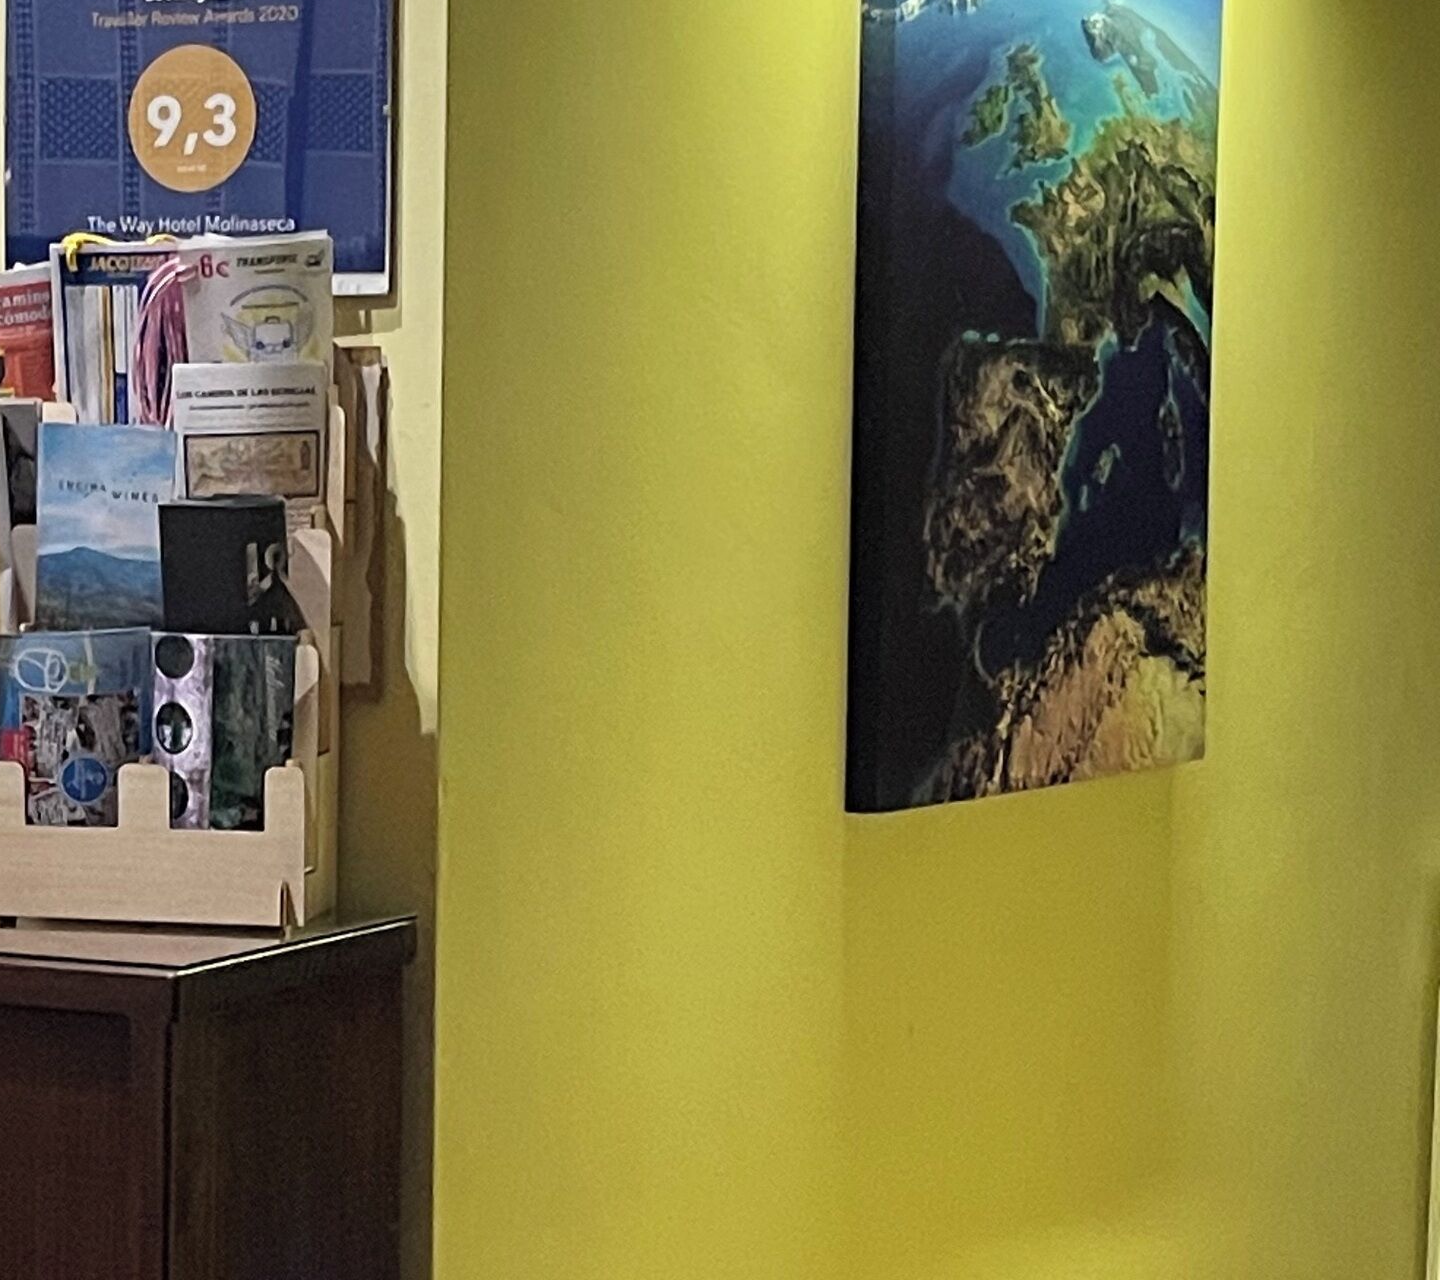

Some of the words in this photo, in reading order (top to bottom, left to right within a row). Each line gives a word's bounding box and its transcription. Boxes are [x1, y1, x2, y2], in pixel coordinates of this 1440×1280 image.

[151, 9, 200, 26] Review
[203, 7, 255, 24] Awards
[258, 4, 299, 22] 2020
[147, 93, 237, 156] 9,3
[87, 215, 117, 233] The
[119, 216, 155, 235] Way
[159, 214, 201, 232] Hotel
[204, 213, 296, 232] Molinaseca
